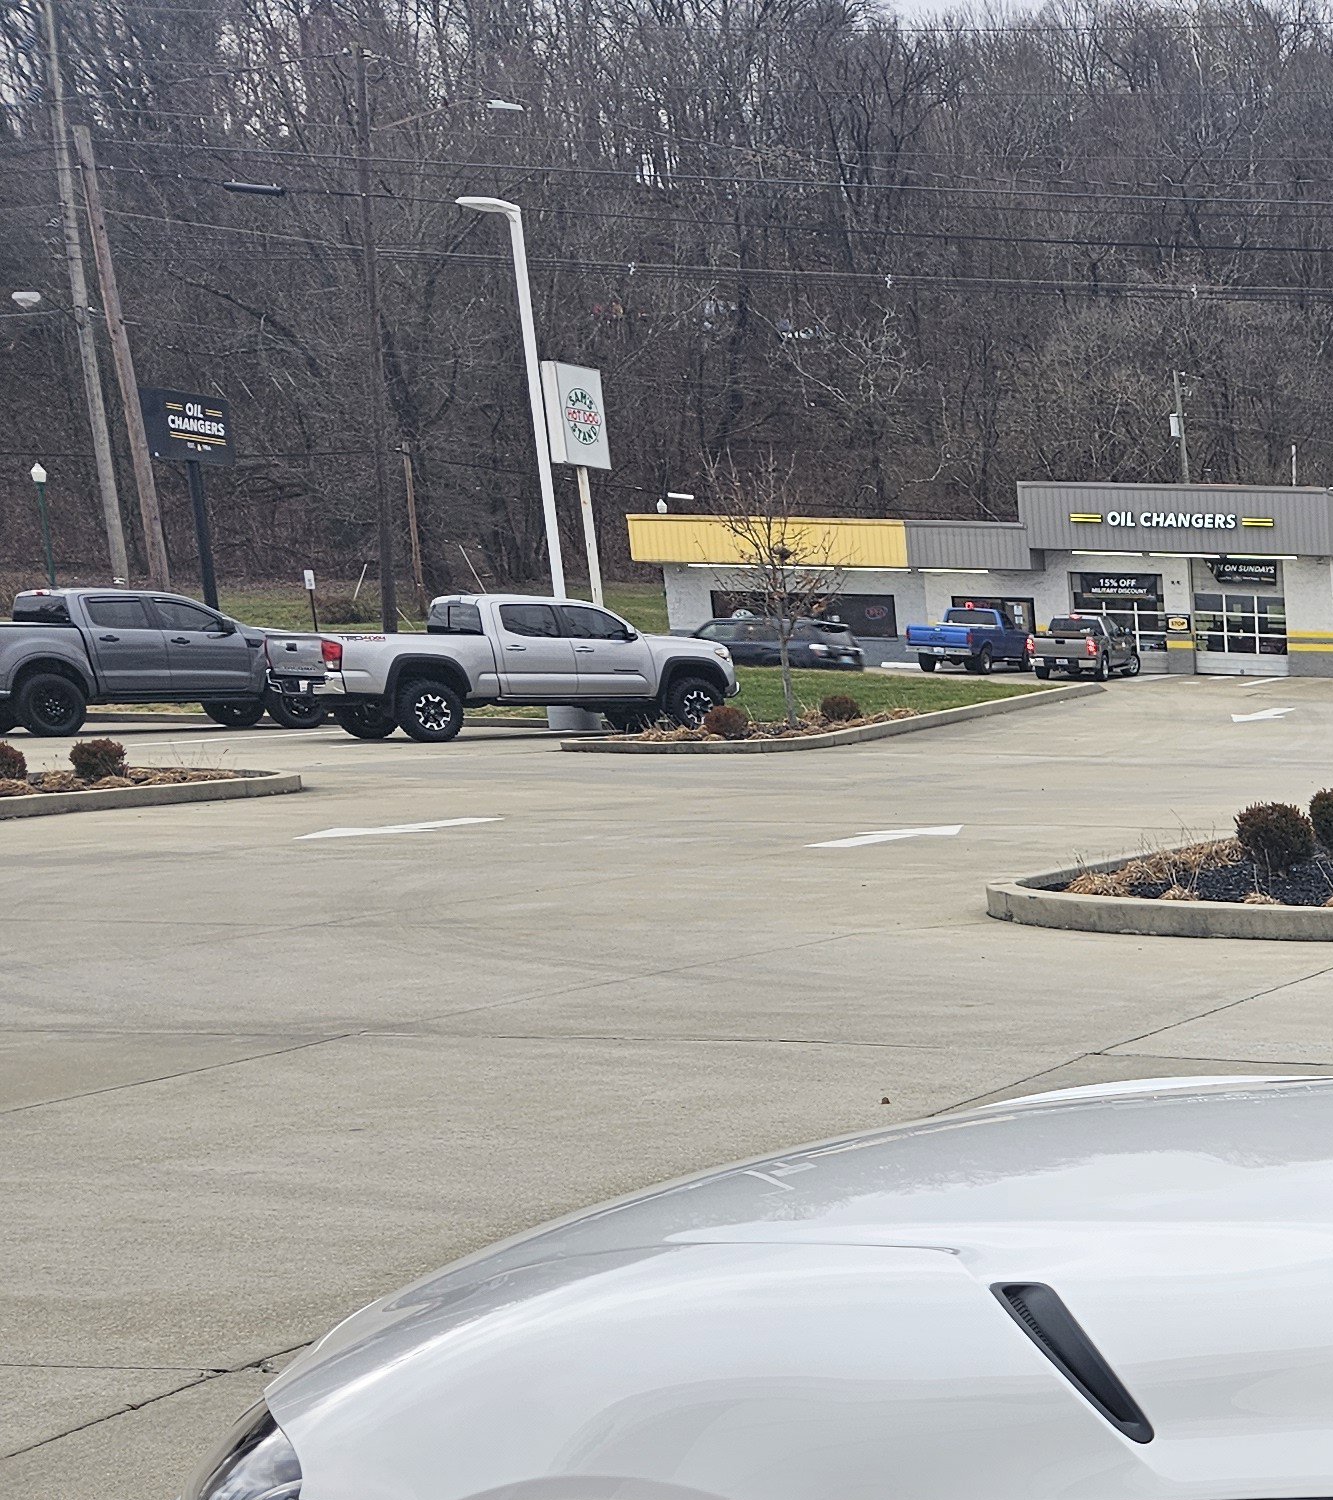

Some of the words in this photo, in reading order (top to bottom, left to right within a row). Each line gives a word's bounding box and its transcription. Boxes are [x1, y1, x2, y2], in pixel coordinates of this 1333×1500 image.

[569, 391, 593, 410] SAM'S
[185, 402, 204, 418] OIL
[568, 410, 581, 420] HOT
[583, 412, 598, 424] DOG
[167, 414, 225, 436] CHANGERS
[571, 423, 597, 442] STAND
[1106, 511, 1136, 527] OIL
[1139, 511, 1237, 529] CHANGERS
[1238, 564, 1275, 573] SUNDAYS
[1099, 578, 1118, 587] 15%
[1119, 579, 1137, 587] OFF
